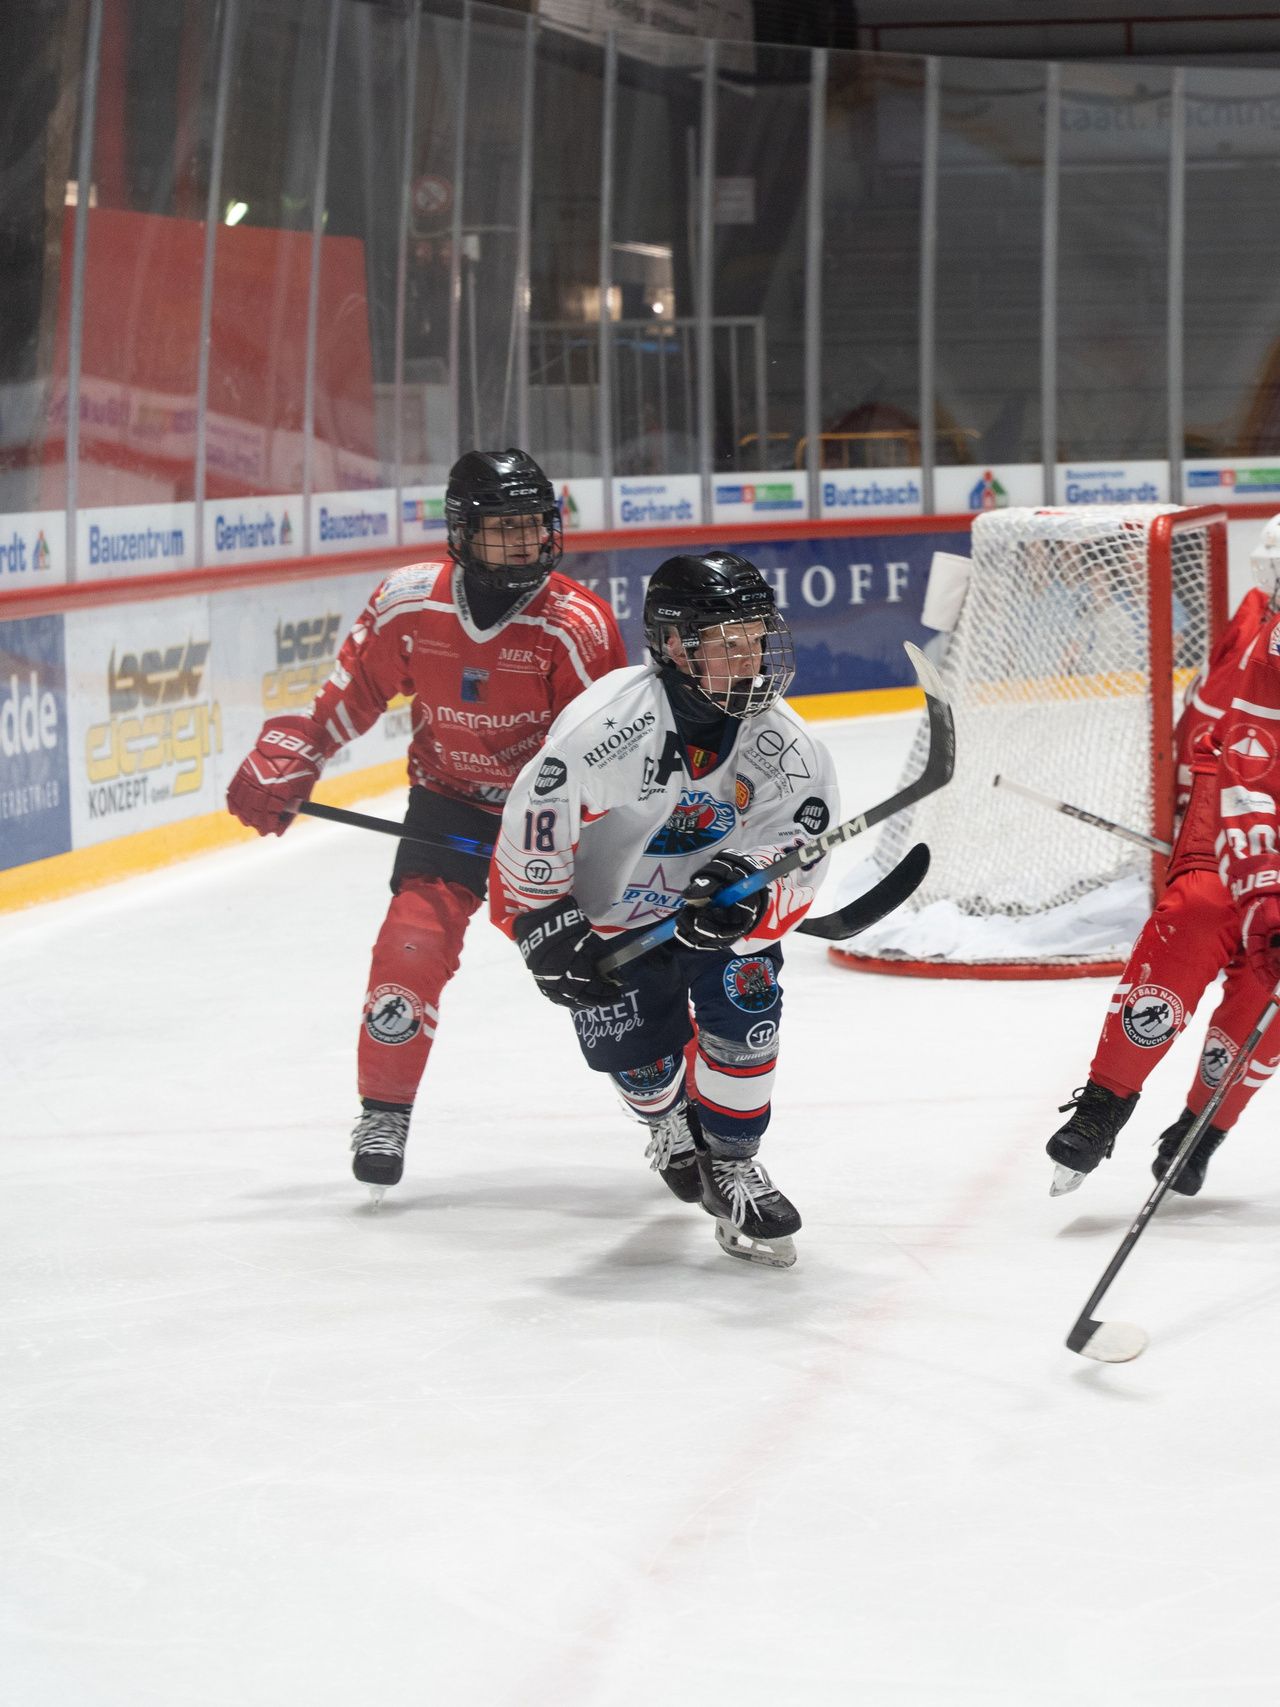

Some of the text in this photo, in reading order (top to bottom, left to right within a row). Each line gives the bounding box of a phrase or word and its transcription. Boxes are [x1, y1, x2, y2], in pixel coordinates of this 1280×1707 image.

[824, 479, 920, 507] Butzbach
[1066, 481, 1159, 503] Gerhardt
[89, 524, 185, 565] Bauzentrum
[658, 607, 682, 617] CCM
[741, 592, 767, 601] CCM
[437, 706, 552, 729] METAWOLF
[261, 729, 326, 770] BAU
[449, 730, 545, 767] STADTWERKE
[582, 711, 656, 767] RHODOS
[453, 762, 482, 773] BAD
[89, 777, 149, 820] KONZEPT
[523, 808, 558, 852] 18
[798, 814, 869, 863] CCM
[519, 885, 559, 895] WARRIOR
[644, 892, 668, 904] ON
[520, 908, 586, 960] BAUER
[1128, 987, 1181, 1026] RT BAD NAUHEIM
[582, 1014, 645, 1049] Burger
[1124, 1017, 1168, 1046] NACHWUCHS
